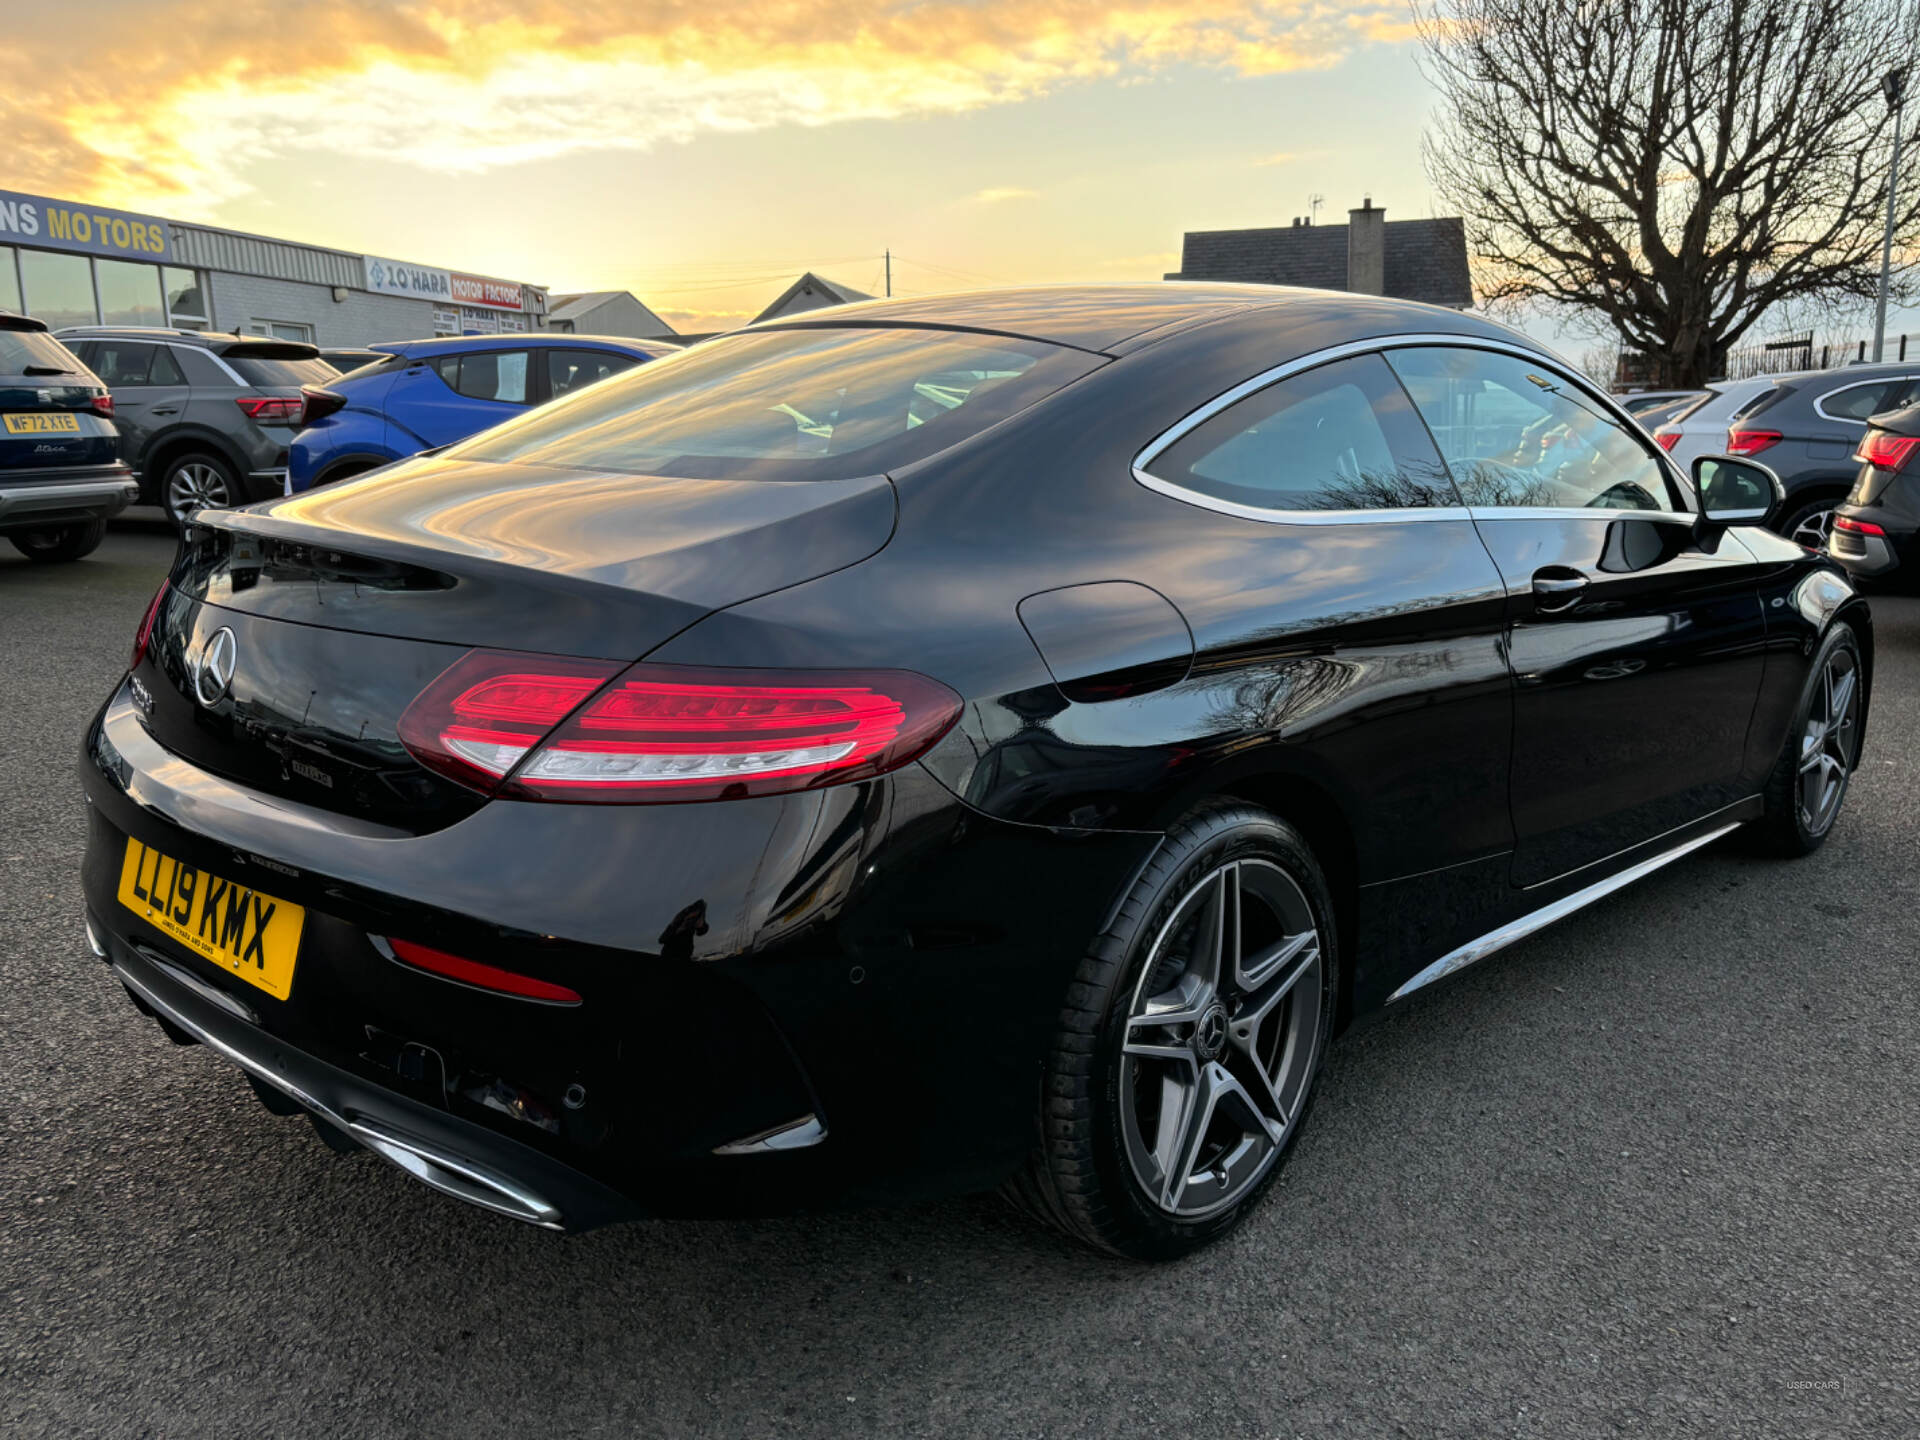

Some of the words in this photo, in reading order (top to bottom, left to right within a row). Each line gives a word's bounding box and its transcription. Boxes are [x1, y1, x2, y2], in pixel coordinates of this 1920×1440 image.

[0, 201, 39, 236] NS
[47, 207, 165, 253] MOTORS
[453, 279, 483, 300] MOTOR
[486, 283, 521, 305] FACTORS
[10, 415, 47, 430] WF72
[47, 415, 74, 429] XTE
[134, 845, 198, 926] LL19
[199, 874, 276, 970] KMX
